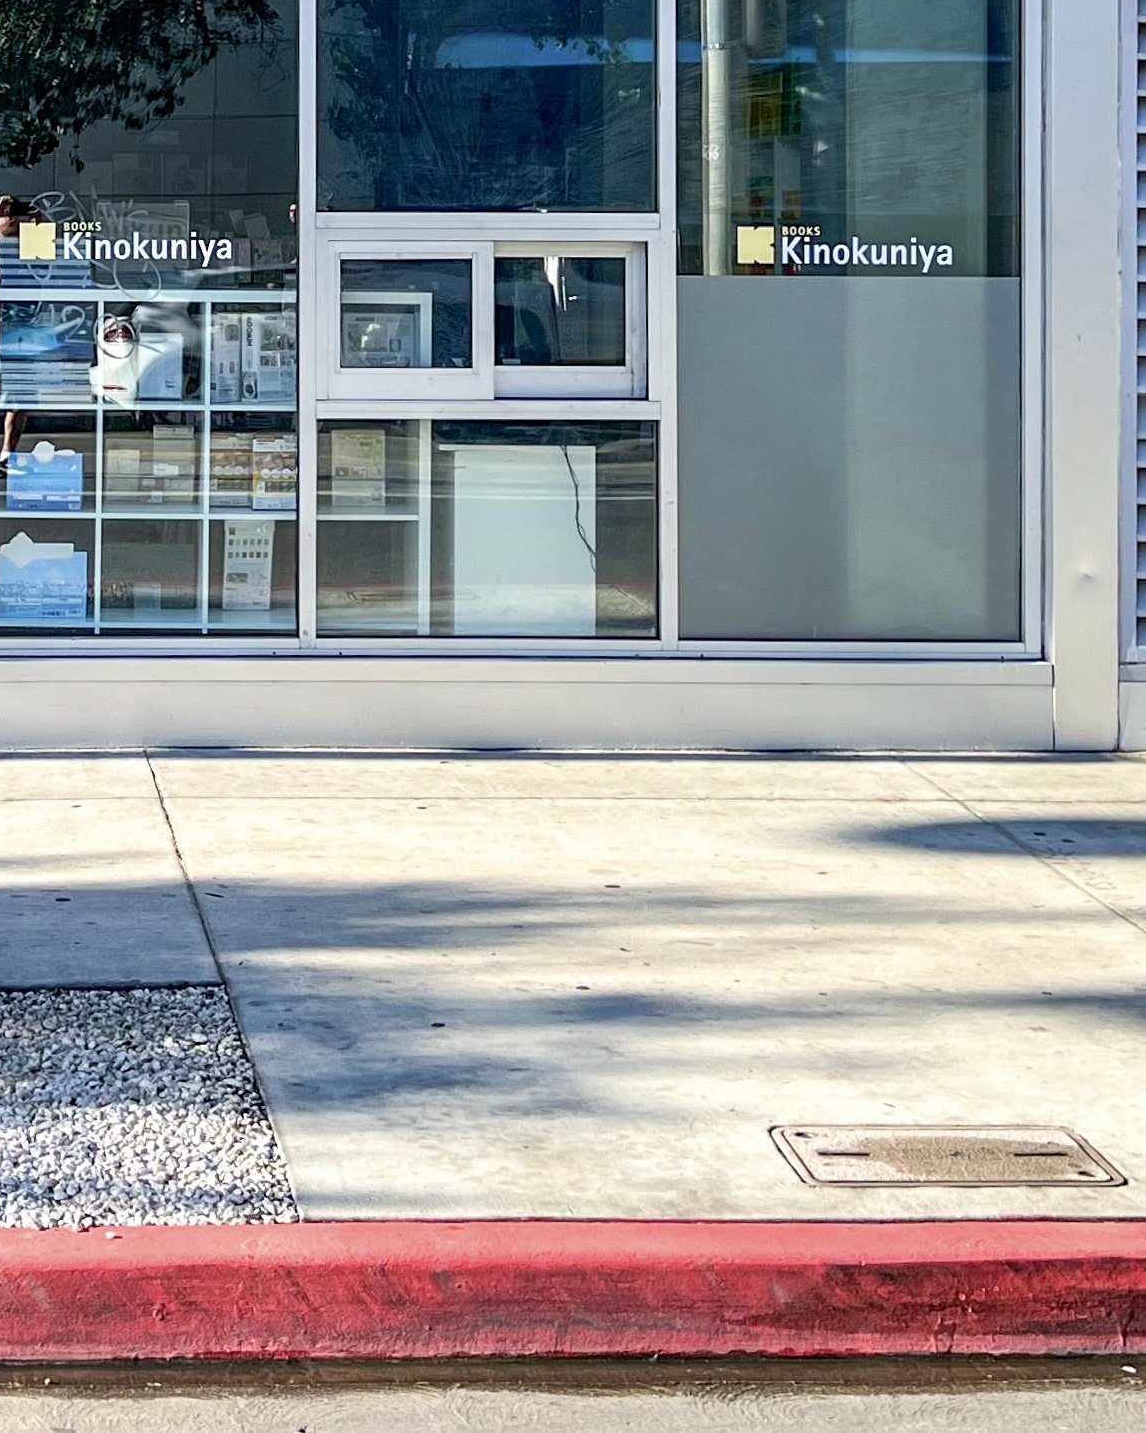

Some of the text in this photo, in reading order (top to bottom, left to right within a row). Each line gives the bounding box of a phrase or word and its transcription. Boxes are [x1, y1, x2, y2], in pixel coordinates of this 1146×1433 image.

[63, 222, 102, 232] BOOKS
[781, 226, 821, 236] BOOKS
[63, 231, 233, 268] Kinokuniya
[781, 236, 954, 274] Kinokuniya
